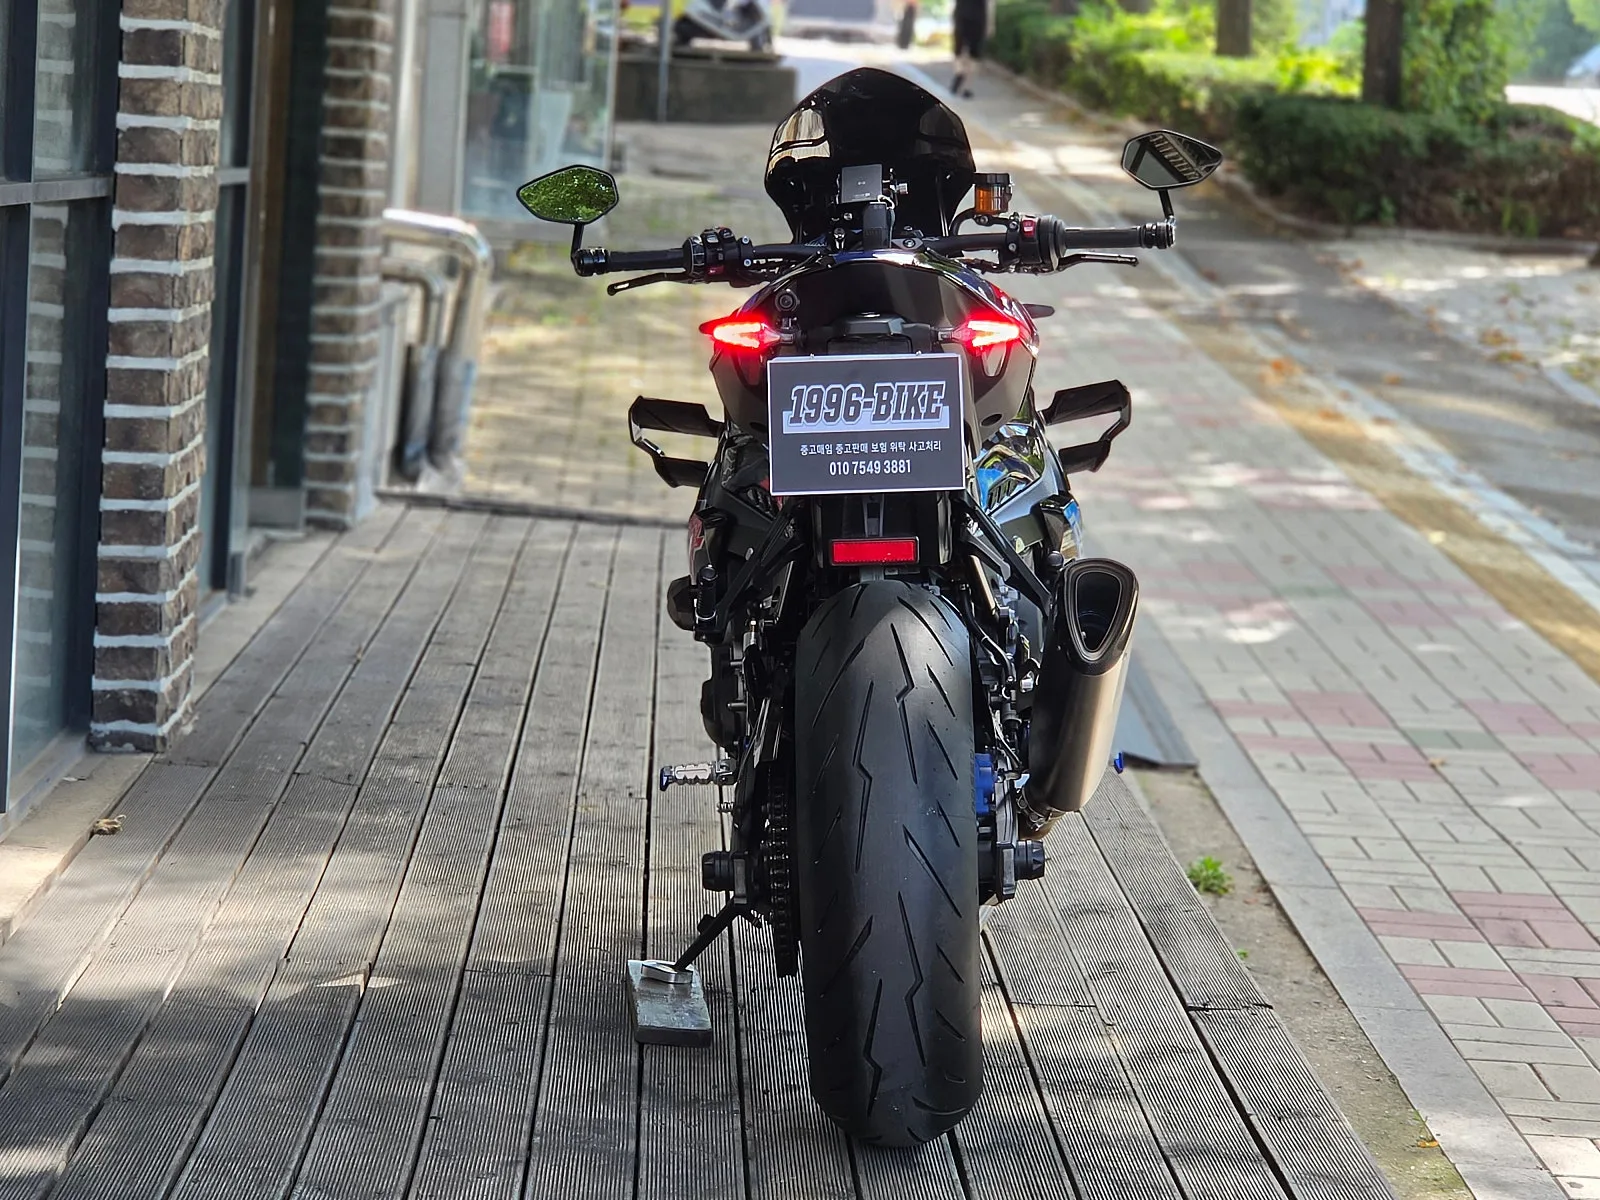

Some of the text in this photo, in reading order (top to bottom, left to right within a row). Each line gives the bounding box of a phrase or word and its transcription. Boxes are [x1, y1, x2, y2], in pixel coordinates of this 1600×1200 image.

[788, 381, 946, 426] 1996-BIKE
[835, 443, 868, 455] 중고판매
[871, 442, 888, 453] 보험
[890, 441, 906, 452] 위탁
[909, 440, 941, 452] 사고처리
[829, 459, 911, 476] 010 7549 3881
